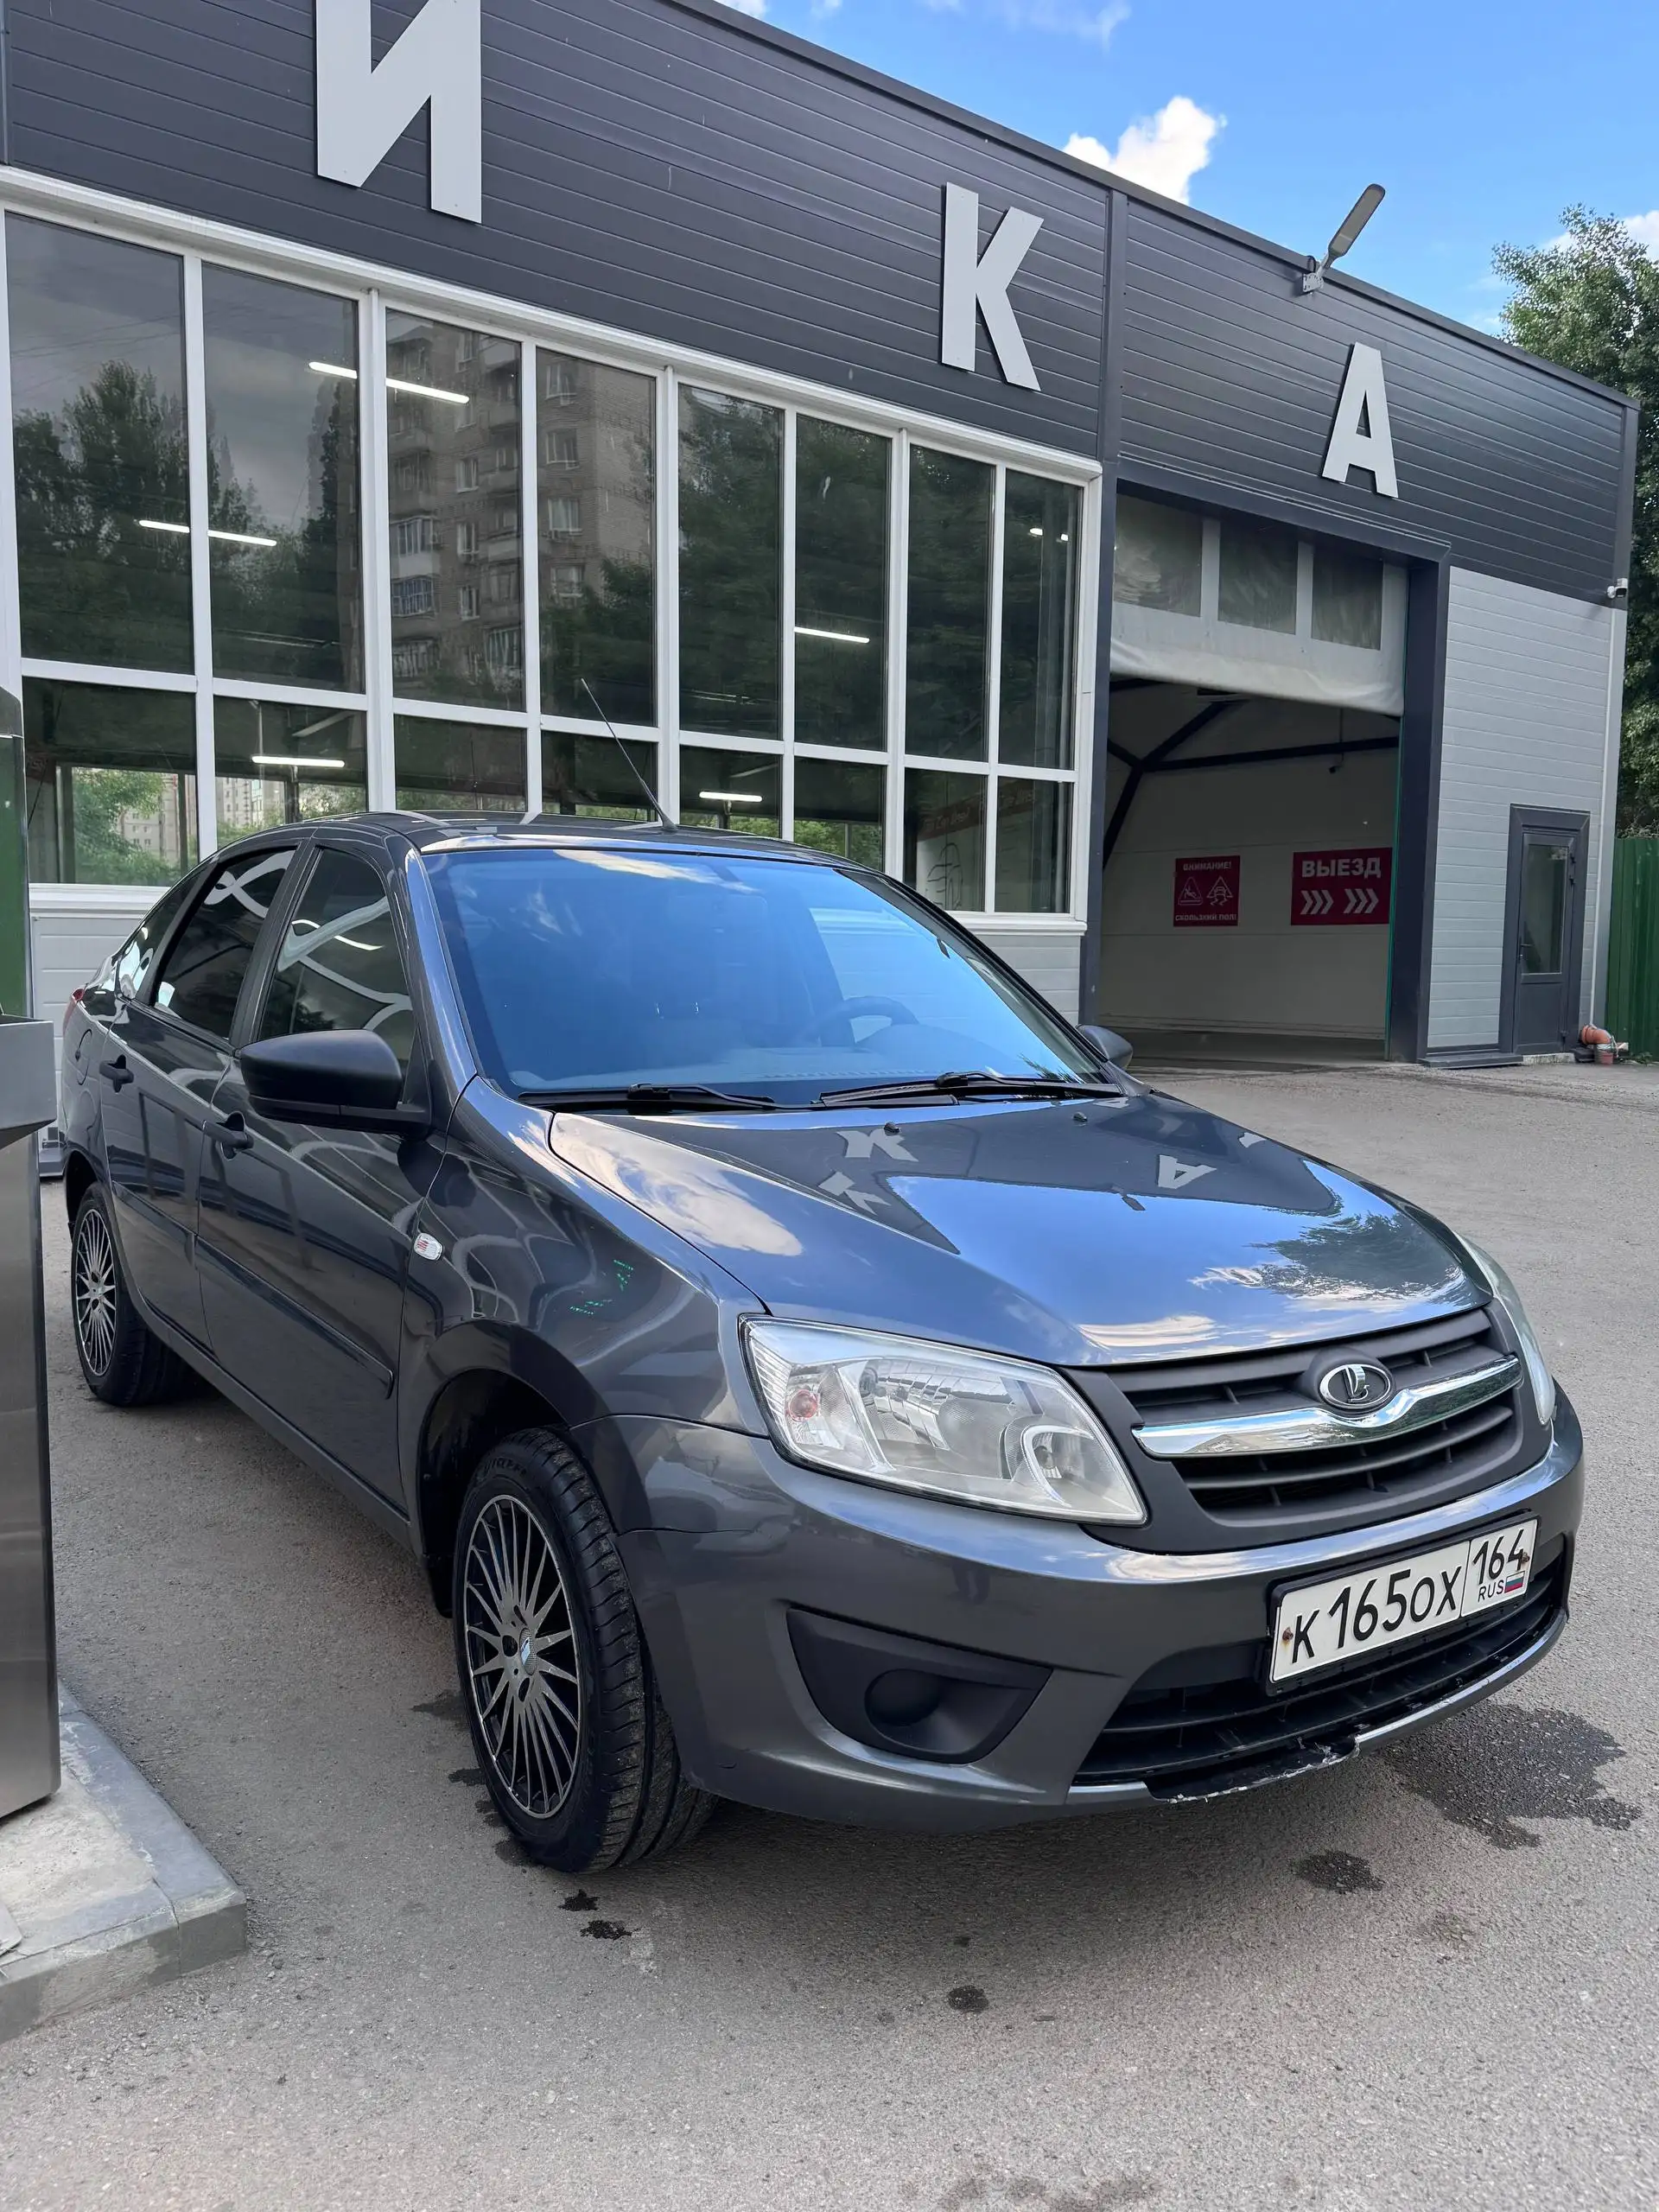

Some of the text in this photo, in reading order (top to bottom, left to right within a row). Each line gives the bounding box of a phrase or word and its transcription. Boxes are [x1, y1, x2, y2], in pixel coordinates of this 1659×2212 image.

[940, 181, 1045, 391] К
[1321, 342, 1399, 499] А
[1183, 861, 1231, 871] ВНИМАНИЕ!
[1301, 857, 1382, 879] ВЫЕЗД
[1472, 1529, 1525, 1585] 164
[1478, 1580, 1504, 1603] RUS
